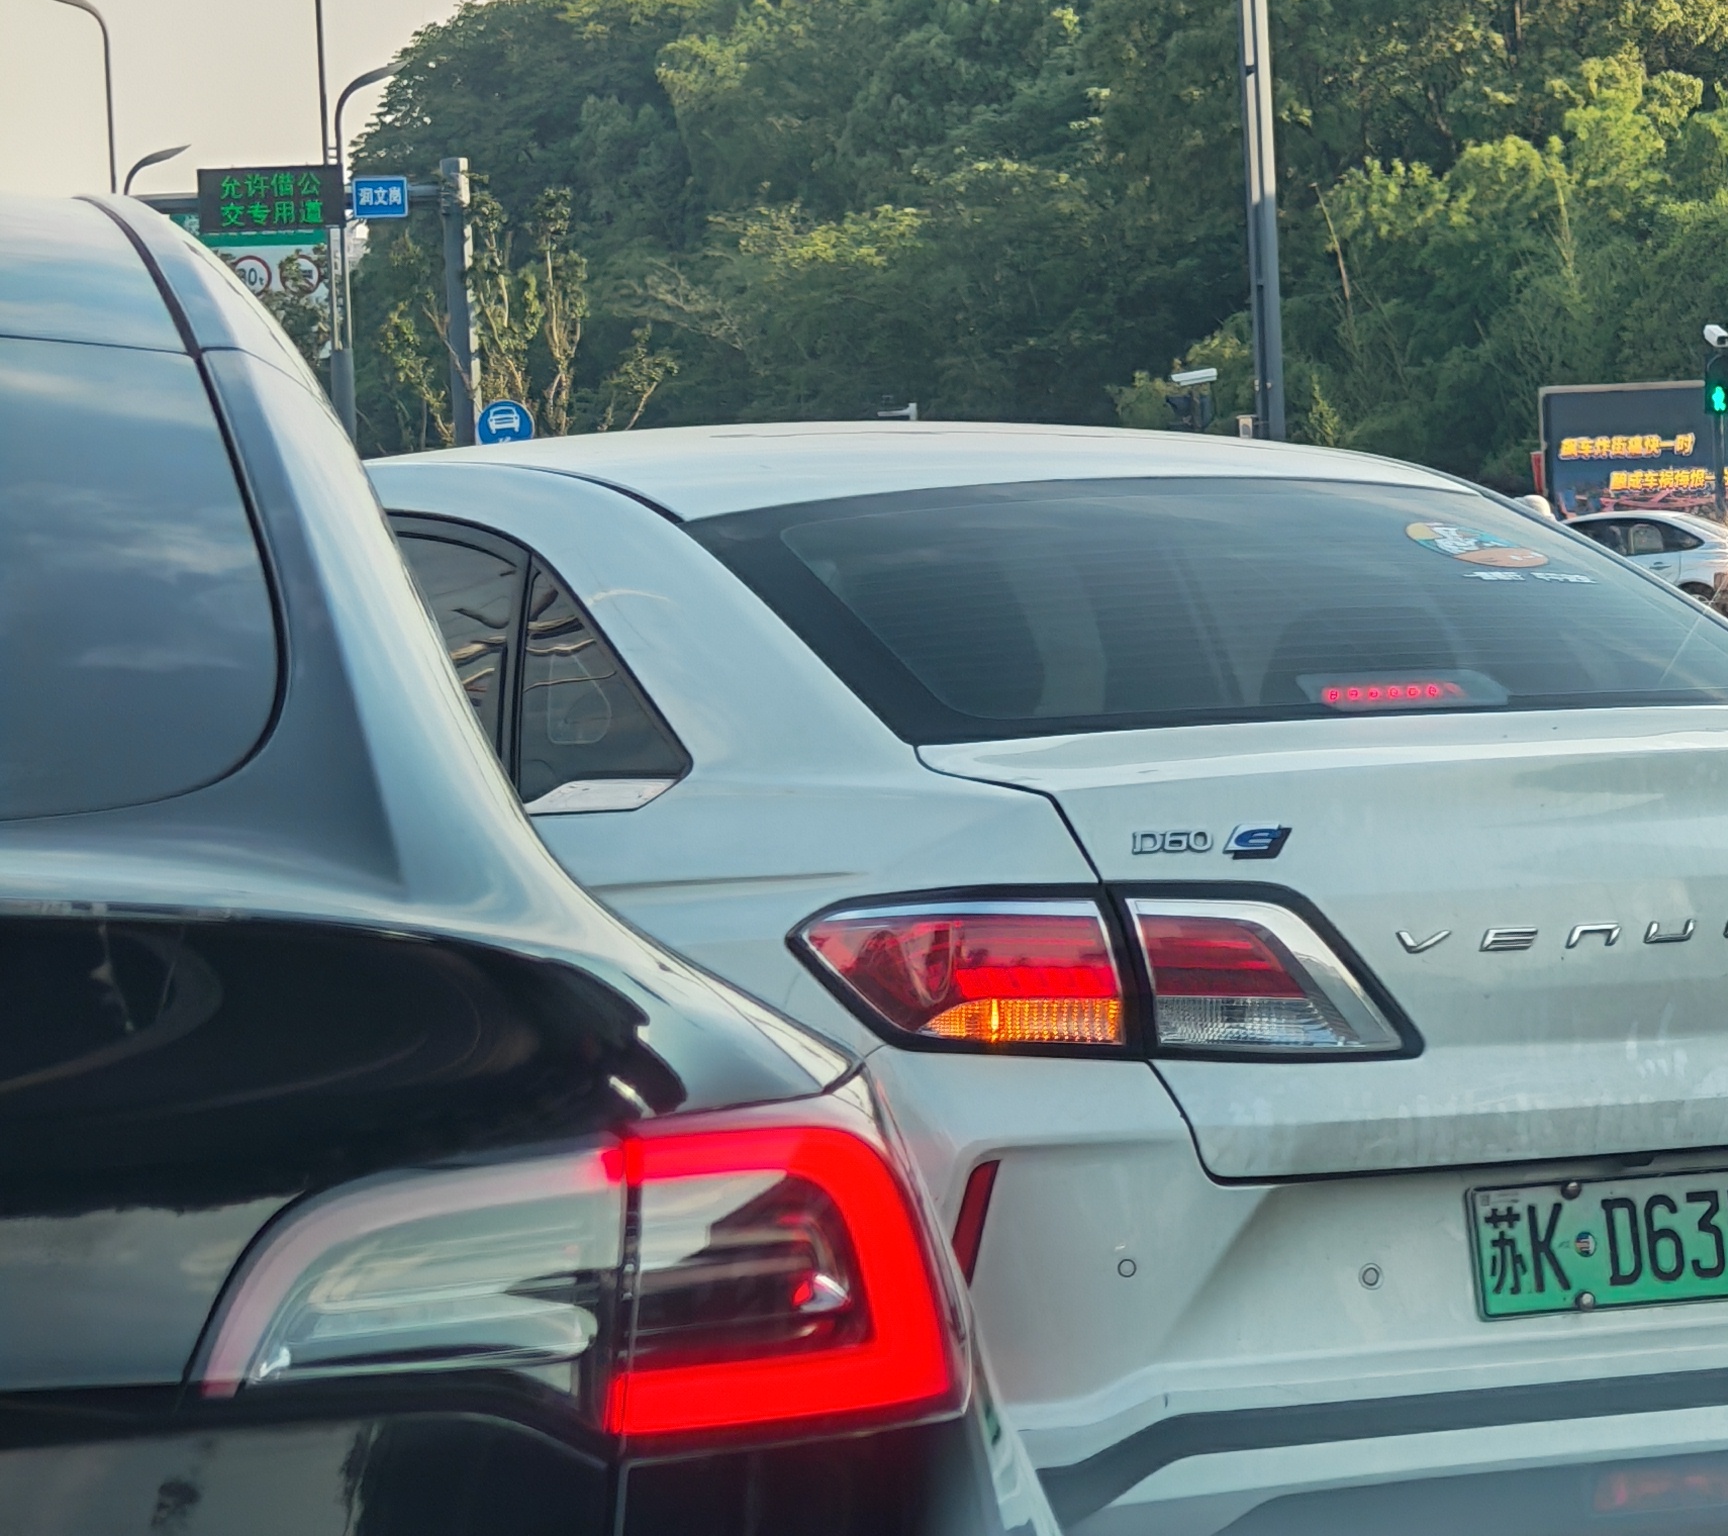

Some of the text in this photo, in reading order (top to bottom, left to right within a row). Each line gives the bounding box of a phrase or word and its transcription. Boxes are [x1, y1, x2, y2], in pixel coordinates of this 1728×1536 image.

[219, 172, 321, 200] 允许借公
[220, 199, 324, 227] 交专用道
[1132, 830, 1214, 855] D60
